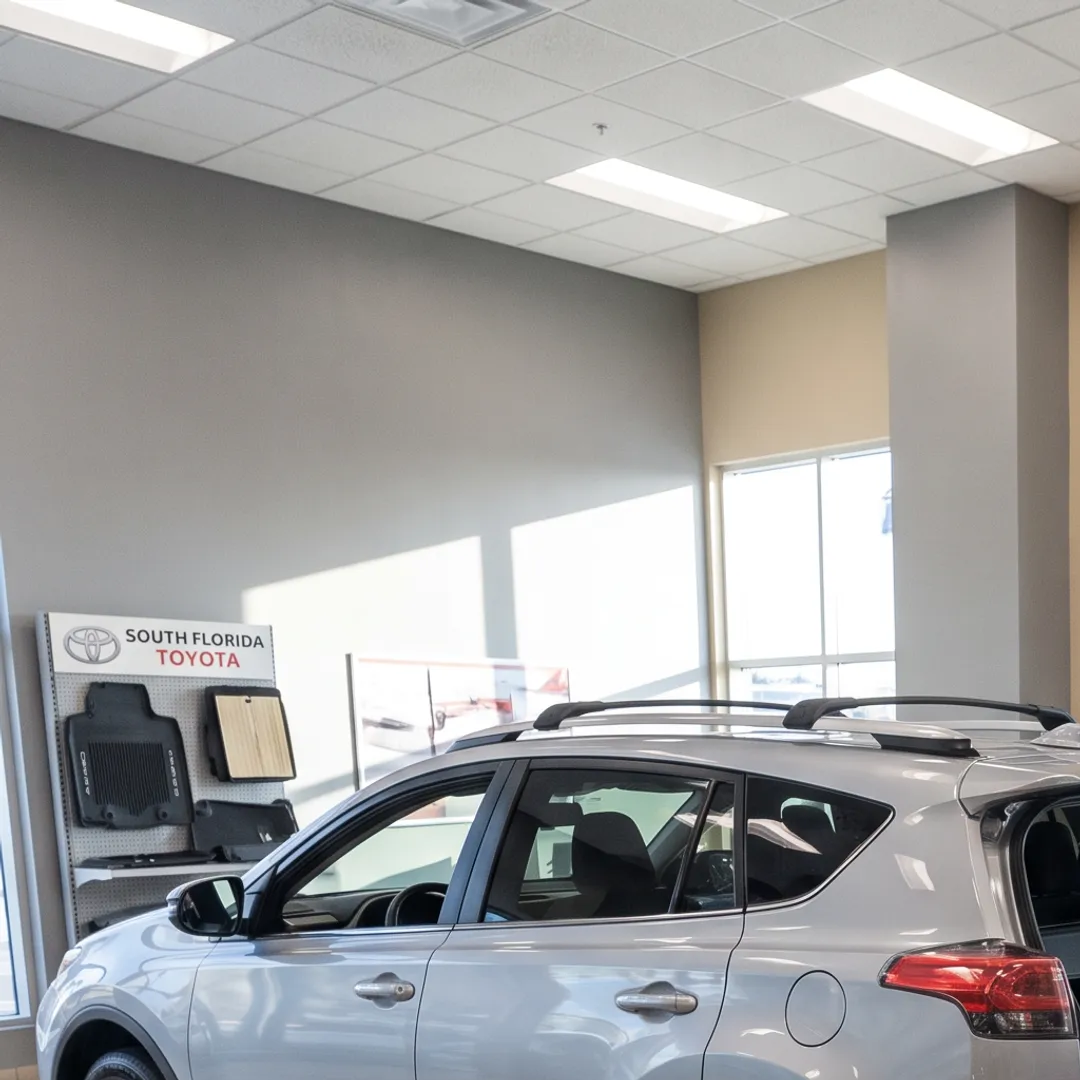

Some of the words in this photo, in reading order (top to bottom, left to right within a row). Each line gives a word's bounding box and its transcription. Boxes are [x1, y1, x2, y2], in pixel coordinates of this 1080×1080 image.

[126, 629, 187, 645] SOUTH
[193, 633, 265, 648] FLORIDA
[156, 649, 241, 668] TOYOTA
